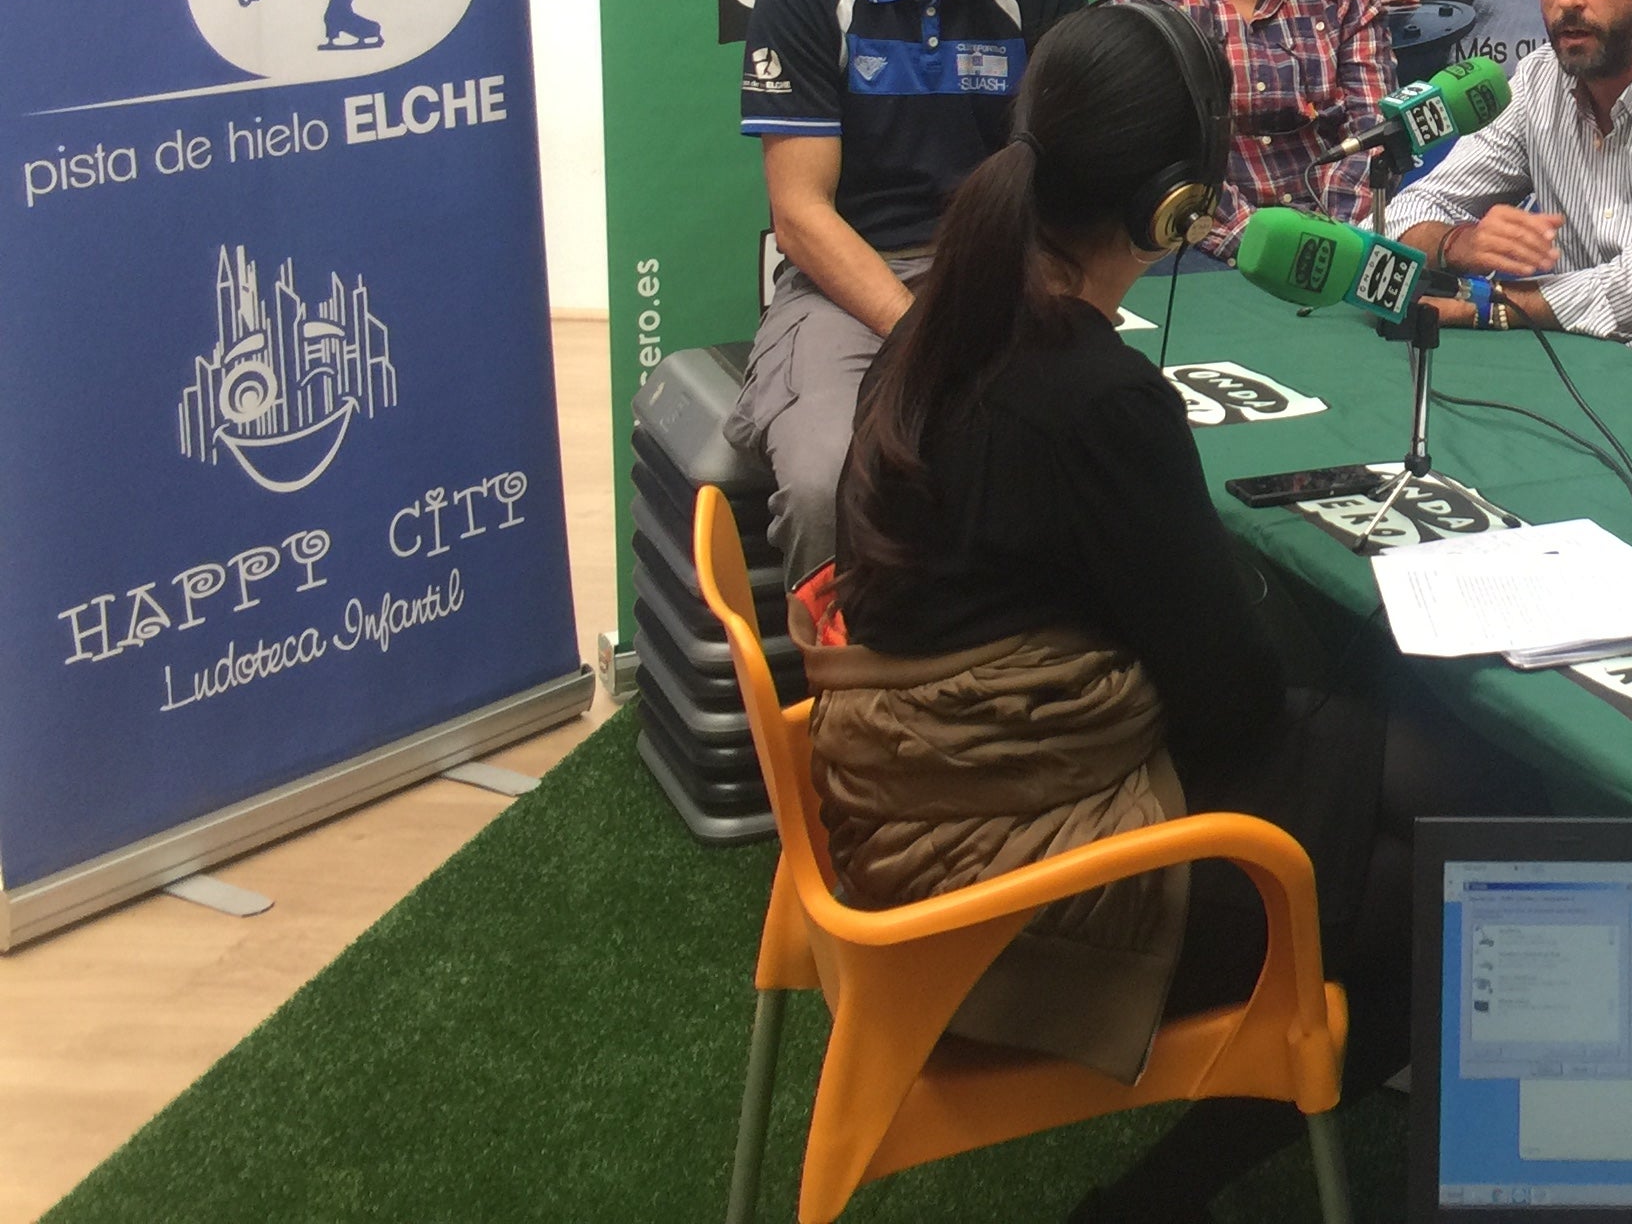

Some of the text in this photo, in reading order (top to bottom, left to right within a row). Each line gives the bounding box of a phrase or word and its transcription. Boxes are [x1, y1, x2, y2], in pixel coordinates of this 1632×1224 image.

[25, 74, 508, 207] pista de hielo ELCHE
[1360, 249, 1381, 293] ONDA
[1384, 261, 1408, 308] CERO
[1317, 498, 1406, 537] ERO
[1382, 475, 1475, 529] NDA
[58, 527, 333, 667] HAPPY
[161, 569, 466, 712] Ludoteca Infantil
